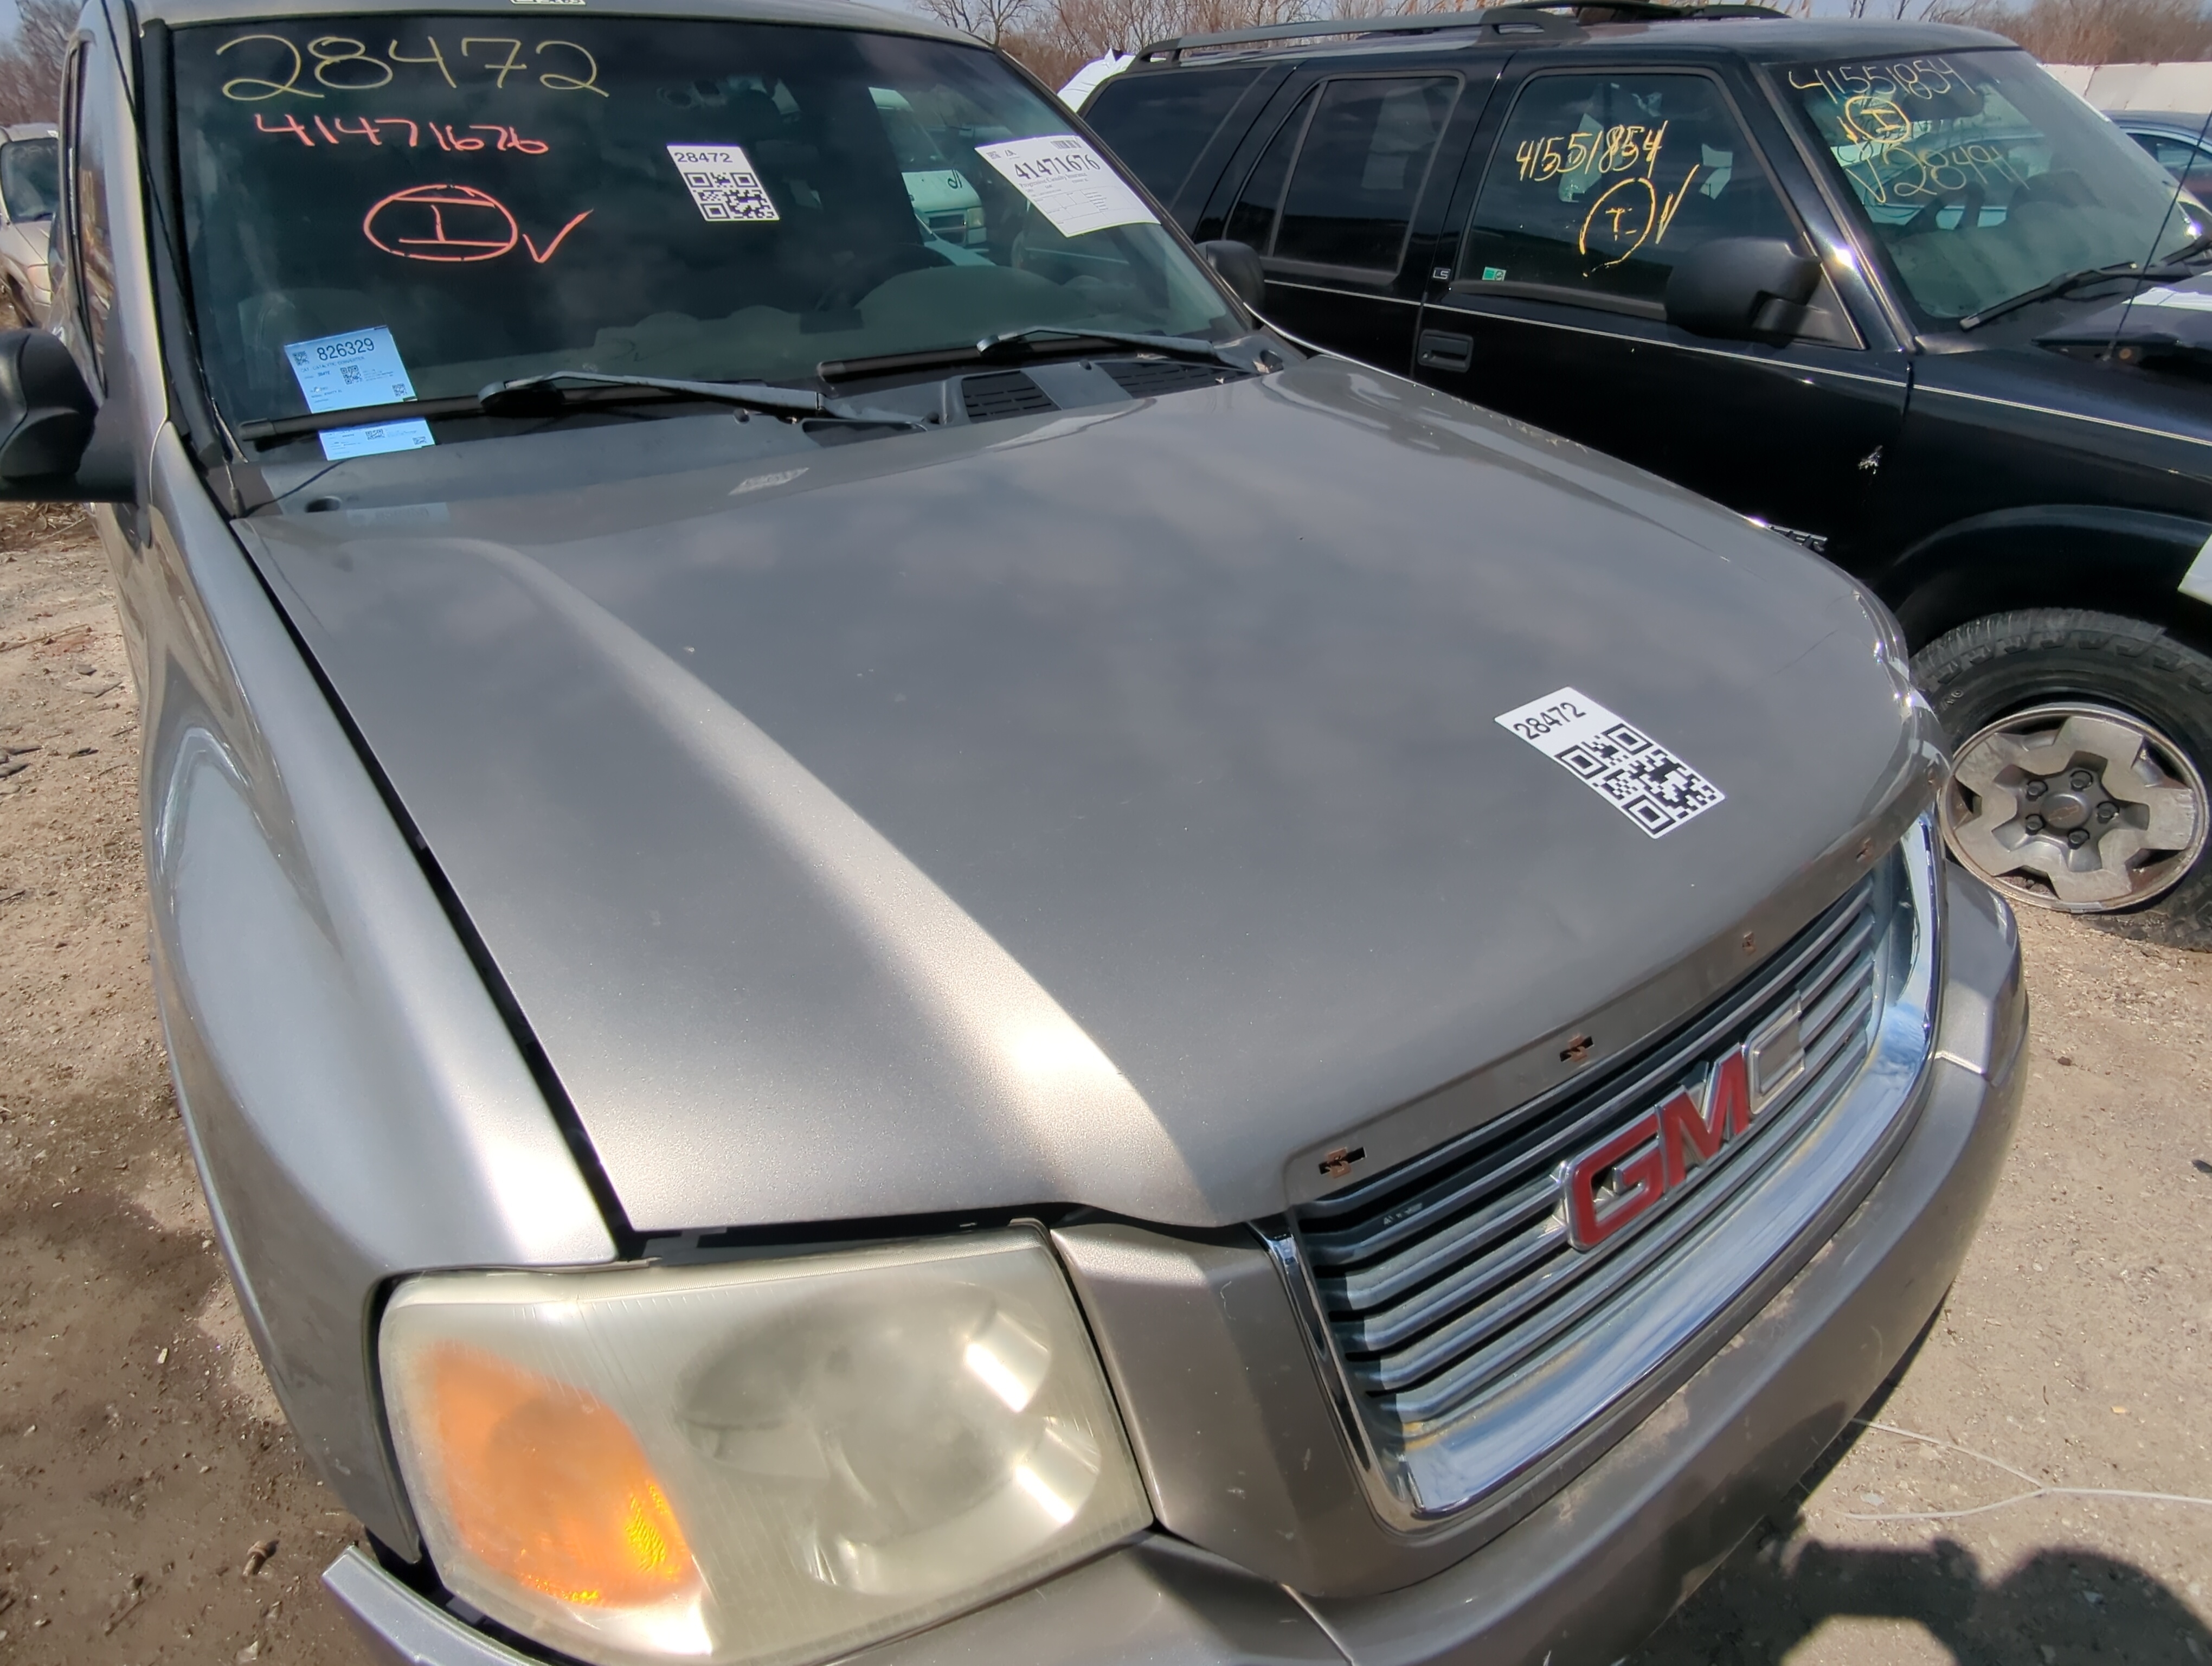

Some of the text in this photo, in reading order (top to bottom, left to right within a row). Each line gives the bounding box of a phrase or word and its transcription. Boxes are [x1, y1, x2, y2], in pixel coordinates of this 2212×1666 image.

[216, 34, 609, 101] 28472
[1788, 57, 1976, 104] 41551854
[255, 113, 549, 154] 41471676
[1516, 120, 1668, 181] 41551854
[674, 152, 733, 163] 28472
[1014, 154, 1101, 180] 41471676
[1433, 270, 1450, 279] LS
[317, 338, 374, 361] 826329
[1513, 702, 1586, 740] 28472
[1563, 988, 1806, 1255] GMC
